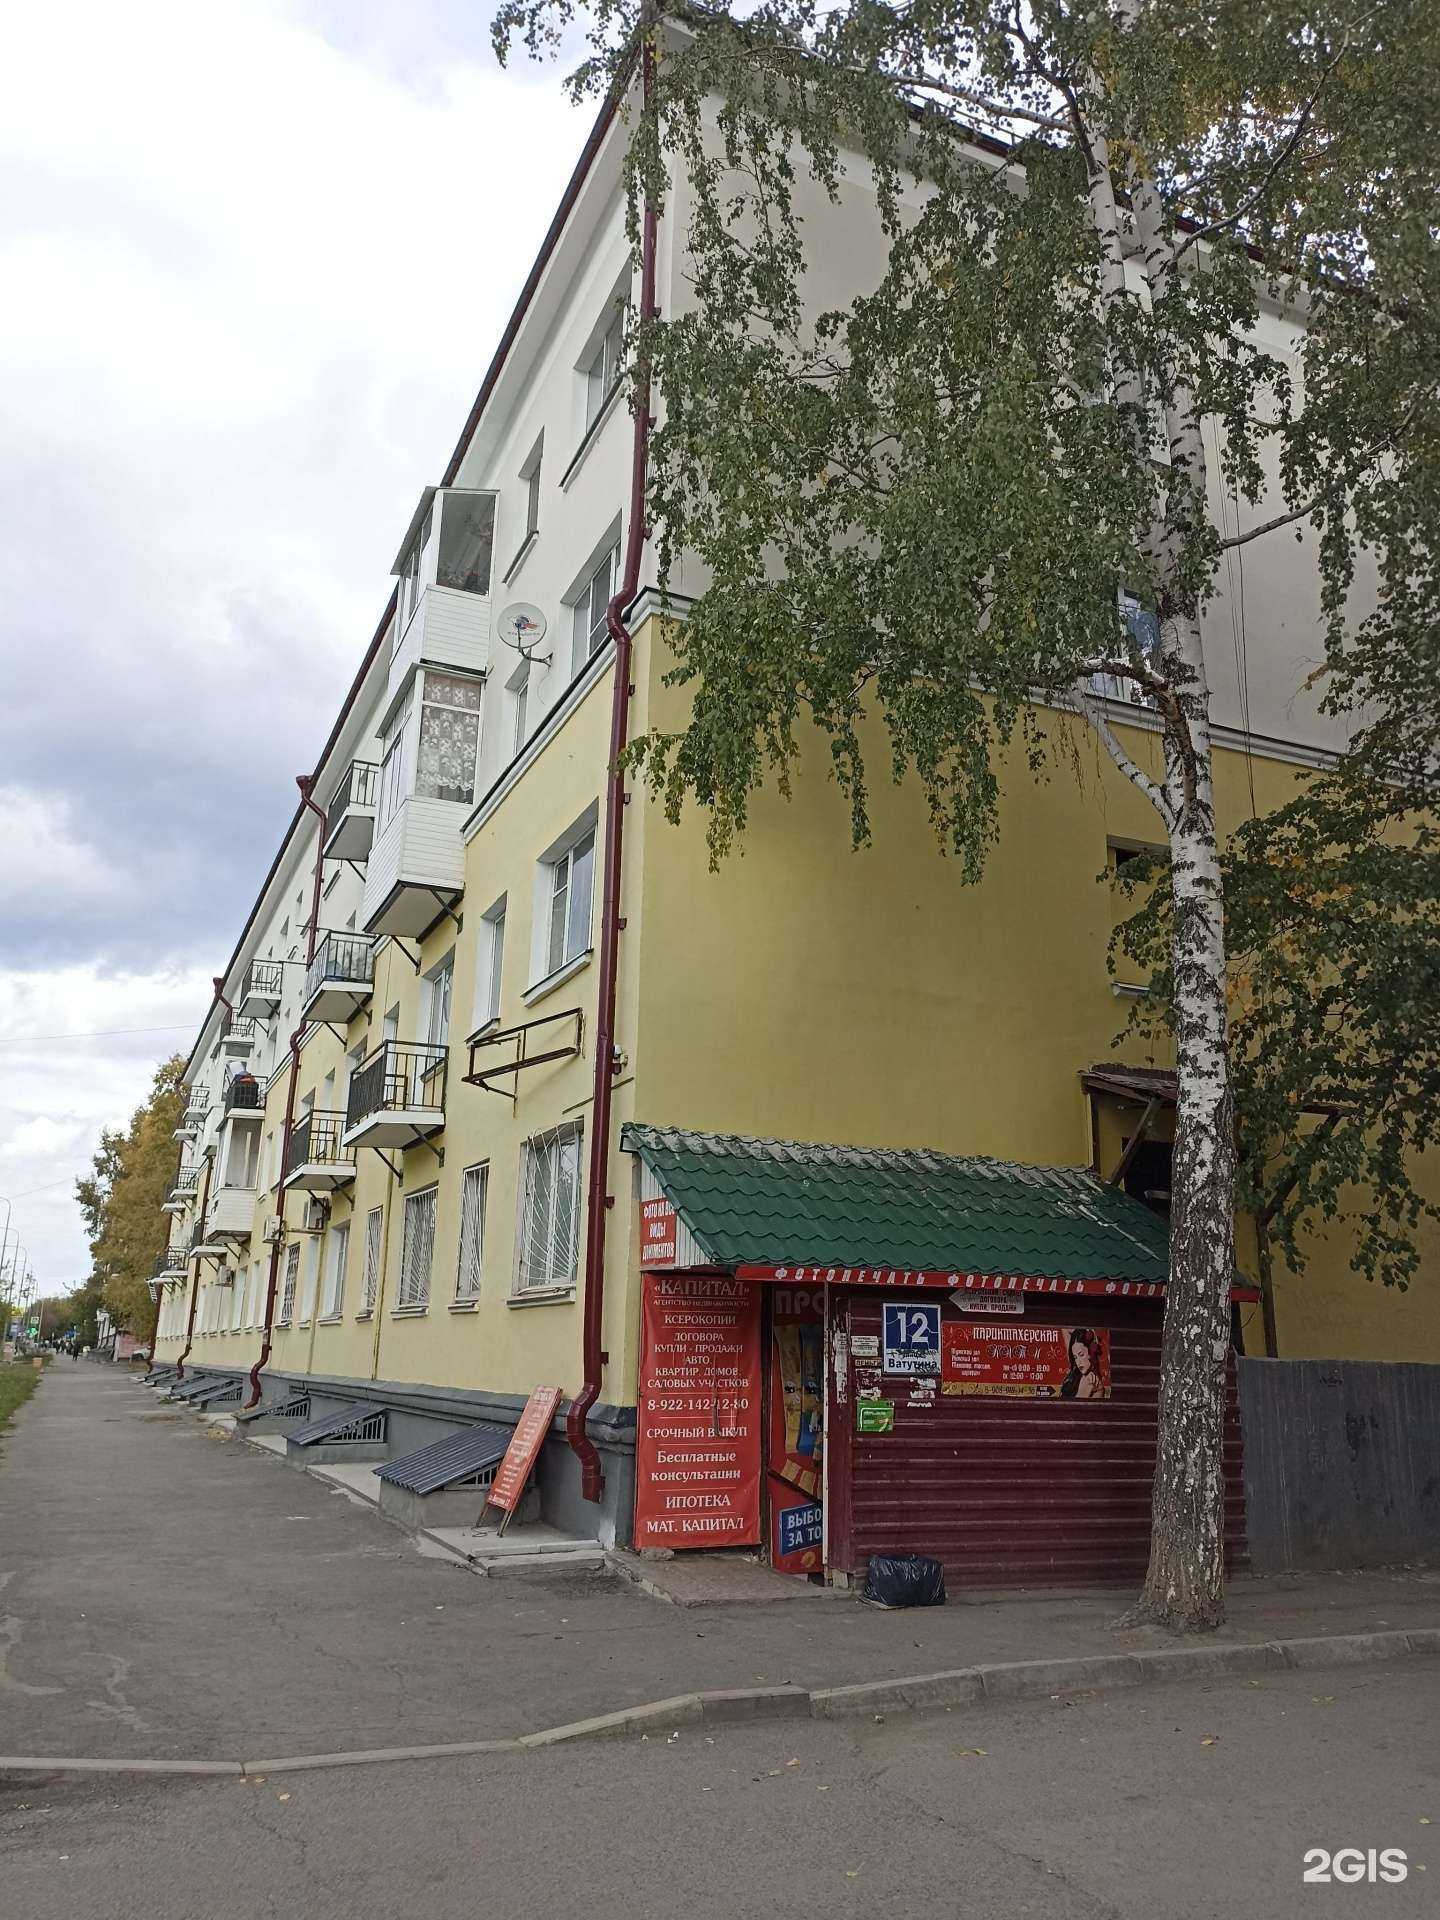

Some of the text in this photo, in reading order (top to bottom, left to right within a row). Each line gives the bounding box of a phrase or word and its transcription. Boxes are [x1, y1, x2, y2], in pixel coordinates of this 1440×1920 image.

[643, 1203, 658, 1219] ФОТО
[642, 1242, 675, 1261] ДОКУМЕНТОВ
[774, 1268, 925, 1285] ФОТОПЕЧАТЬ
[947, 1274, 1084, 1291] ФОТОПЕЧАТЬ
[664, 1314, 737, 1325] КСЕРОКОПИИ
[897, 1311, 929, 1343] 12
[673, 1332, 724, 1342] ДОГОВОРА
[973, 1327, 1058, 1343] ПАРИКМАХЕРСКАЯ
[654, 1343, 687, 1353] КУПЛИ
[695, 1344, 743, 1354] ПРОДАЖИ
[888, 1358, 938, 1371] Ватутина
[646, 1426, 704, 1438] СРОЧНЫЙ
[657, 1450, 737, 1464] Бесплатные
[651, 1470, 741, 1482] консультации
[665, 1494, 732, 1509] ИПОТЕКА
[646, 1517, 744, 1533] МАТ. КАПИТАЛ
[788, 1530, 804, 1547] ЗА
